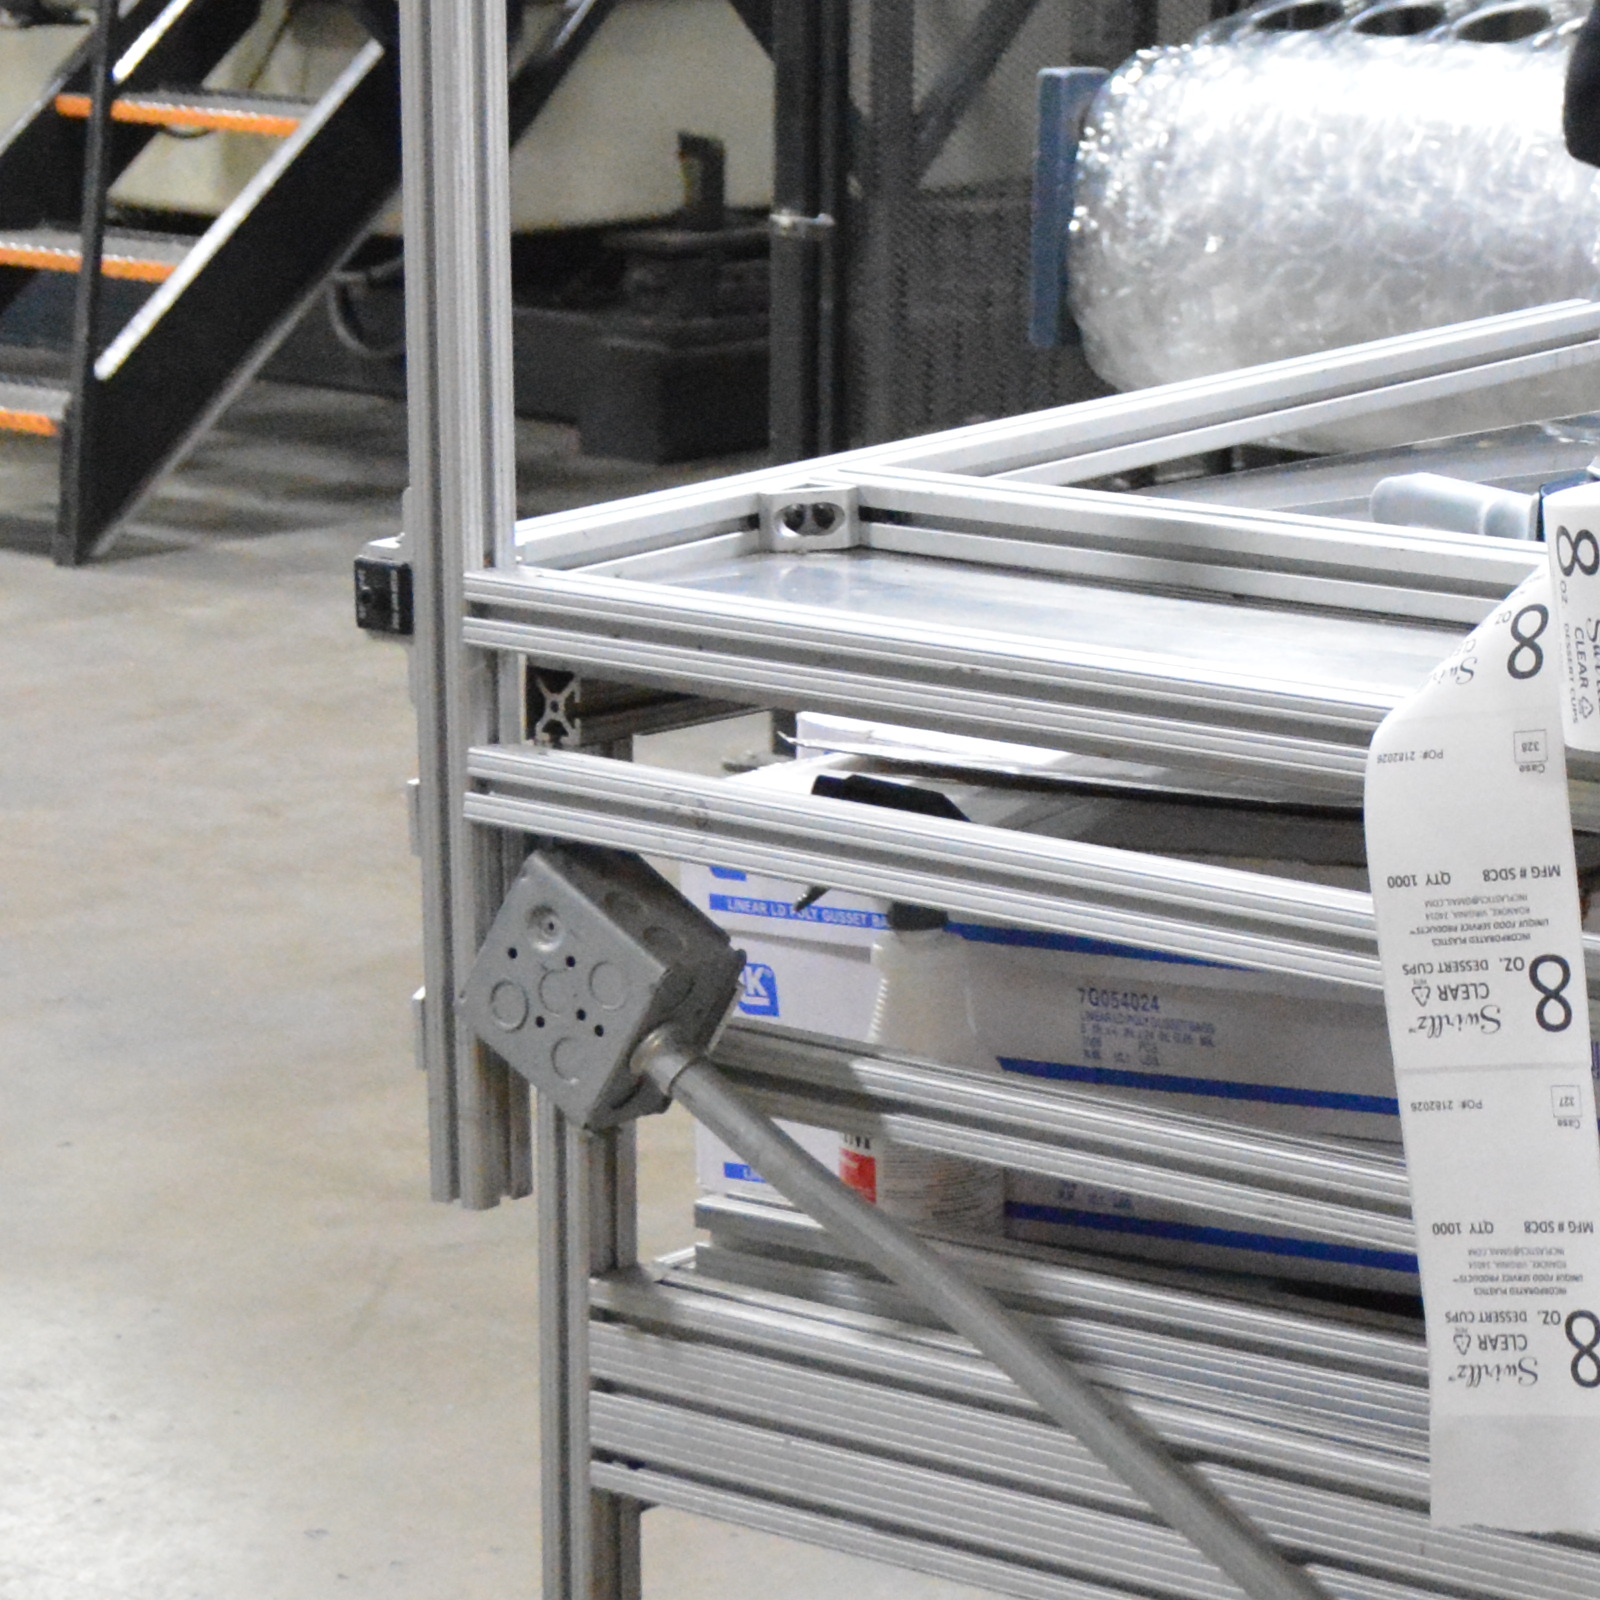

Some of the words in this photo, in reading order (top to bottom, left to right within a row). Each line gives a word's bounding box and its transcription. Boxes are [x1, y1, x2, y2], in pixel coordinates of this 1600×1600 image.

[1556, 525, 1600, 577] 8
[1507, 604, 1549, 679] 8
[1564, 623, 1574, 682] DESSERT
[1574, 627, 1589, 688] CLEAR
[1570, 687, 1578, 724] CUPS
[1521, 741, 1540, 752] 328
[1377, 750, 1415, 763] 2182026
[1519, 763, 1545, 773] Case
[1483, 867, 1516, 882] SDC8
[1520, 867, 1527, 878] #
[1531, 865, 1561, 878] MFG
[1387, 874, 1418, 888] 1000
[1425, 871, 1451, 886] QTY
[727, 899, 768, 914] LINEAR
[770, 903, 786, 917] LD
[822, 909, 868, 926] GUSSET
[1460, 922, 1491, 931] SERVICE
[1493, 920, 1516, 929] FOOD
[1519, 918, 1549, 928] UNIQUE
[1431, 937, 1467, 947] PLASTICS
[1469, 932, 1531, 944] INCORPORATED
[1402, 962, 1433, 975] CUPS
[1437, 959, 1489, 974] DESSERT
[1499, 956, 1525, 972] OZ.
[1437, 982, 1490, 1001] CLEAR
[1528, 954, 1572, 1032] 8
[1410, 1100, 1453, 1112] 2182026
[1557, 1119, 1581, 1129] Case
[1432, 1222, 1462, 1235] 1000
[1469, 1220, 1494, 1235] QTY
[1523, 1220, 1555, 1233] SDC8
[1557, 1221, 1565, 1232] #
[1568, 1220, 1594, 1234] MFG
[1502, 1273, 1531, 1282] SERVICE
[1532, 1273, 1554, 1282] FOOD
[1556, 1273, 1584, 1282] UNIQUE
[1473, 1287, 1508, 1296] PLASTICS
[1509, 1287, 1567, 1296] INCORPORATED
[1445, 1311, 1475, 1324] CUPS
[1478, 1310, 1527, 1323] DESSERT
[1537, 1310, 1561, 1325] OZ.
[1477, 1333, 1528, 1351] CLEAR
